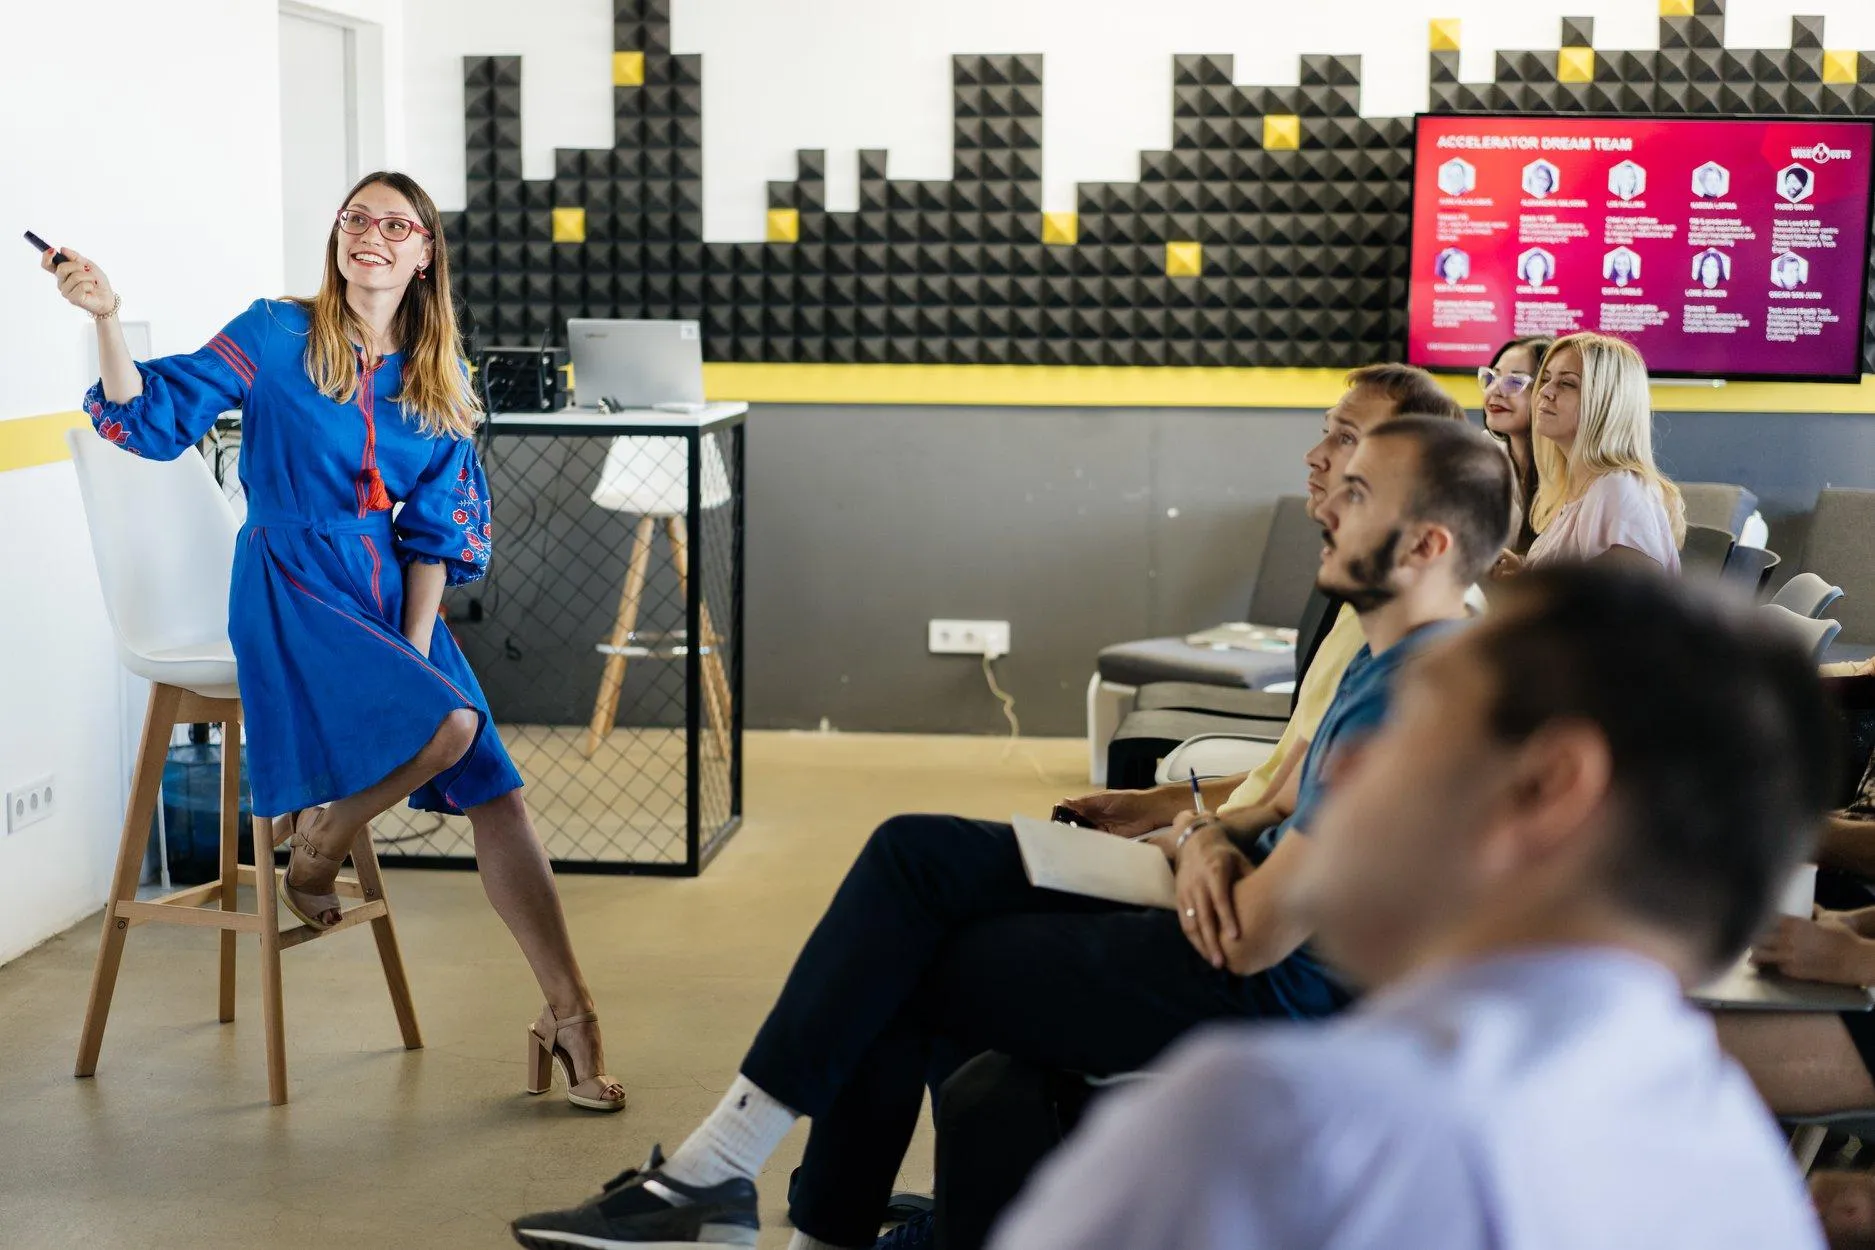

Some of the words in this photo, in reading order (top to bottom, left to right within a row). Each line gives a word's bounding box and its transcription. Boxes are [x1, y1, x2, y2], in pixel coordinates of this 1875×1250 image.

[1437, 135, 1539, 149] ACCELERATOR
[1541, 136, 1591, 151] DREAM
[1593, 137, 1633, 151] TEAM
